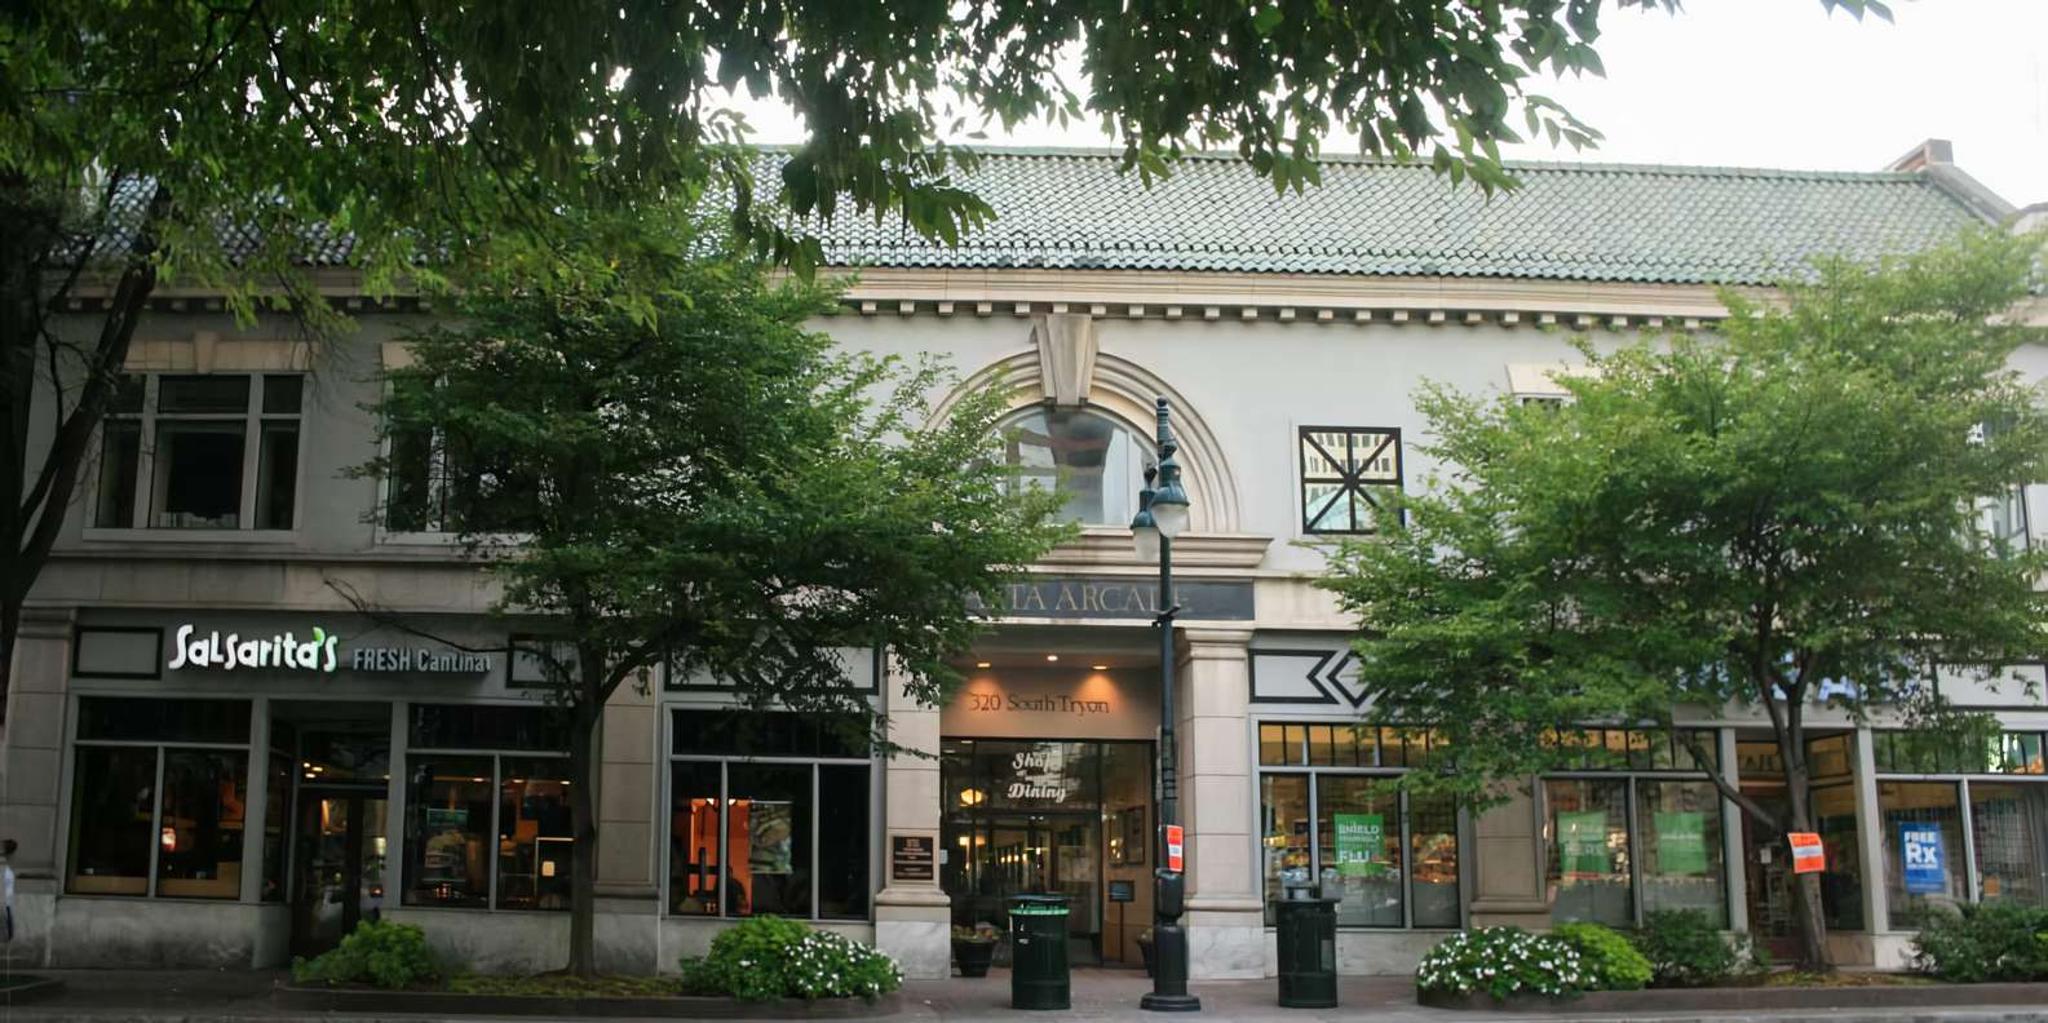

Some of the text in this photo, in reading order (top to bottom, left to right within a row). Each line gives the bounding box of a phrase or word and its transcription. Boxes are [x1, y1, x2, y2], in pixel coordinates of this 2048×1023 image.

[353, 648, 411, 671] FRESH
[968, 693, 1109, 716] 320 South Tryon
[1008, 783, 1066, 803] Dining
[1906, 843, 1937, 864] Rx
